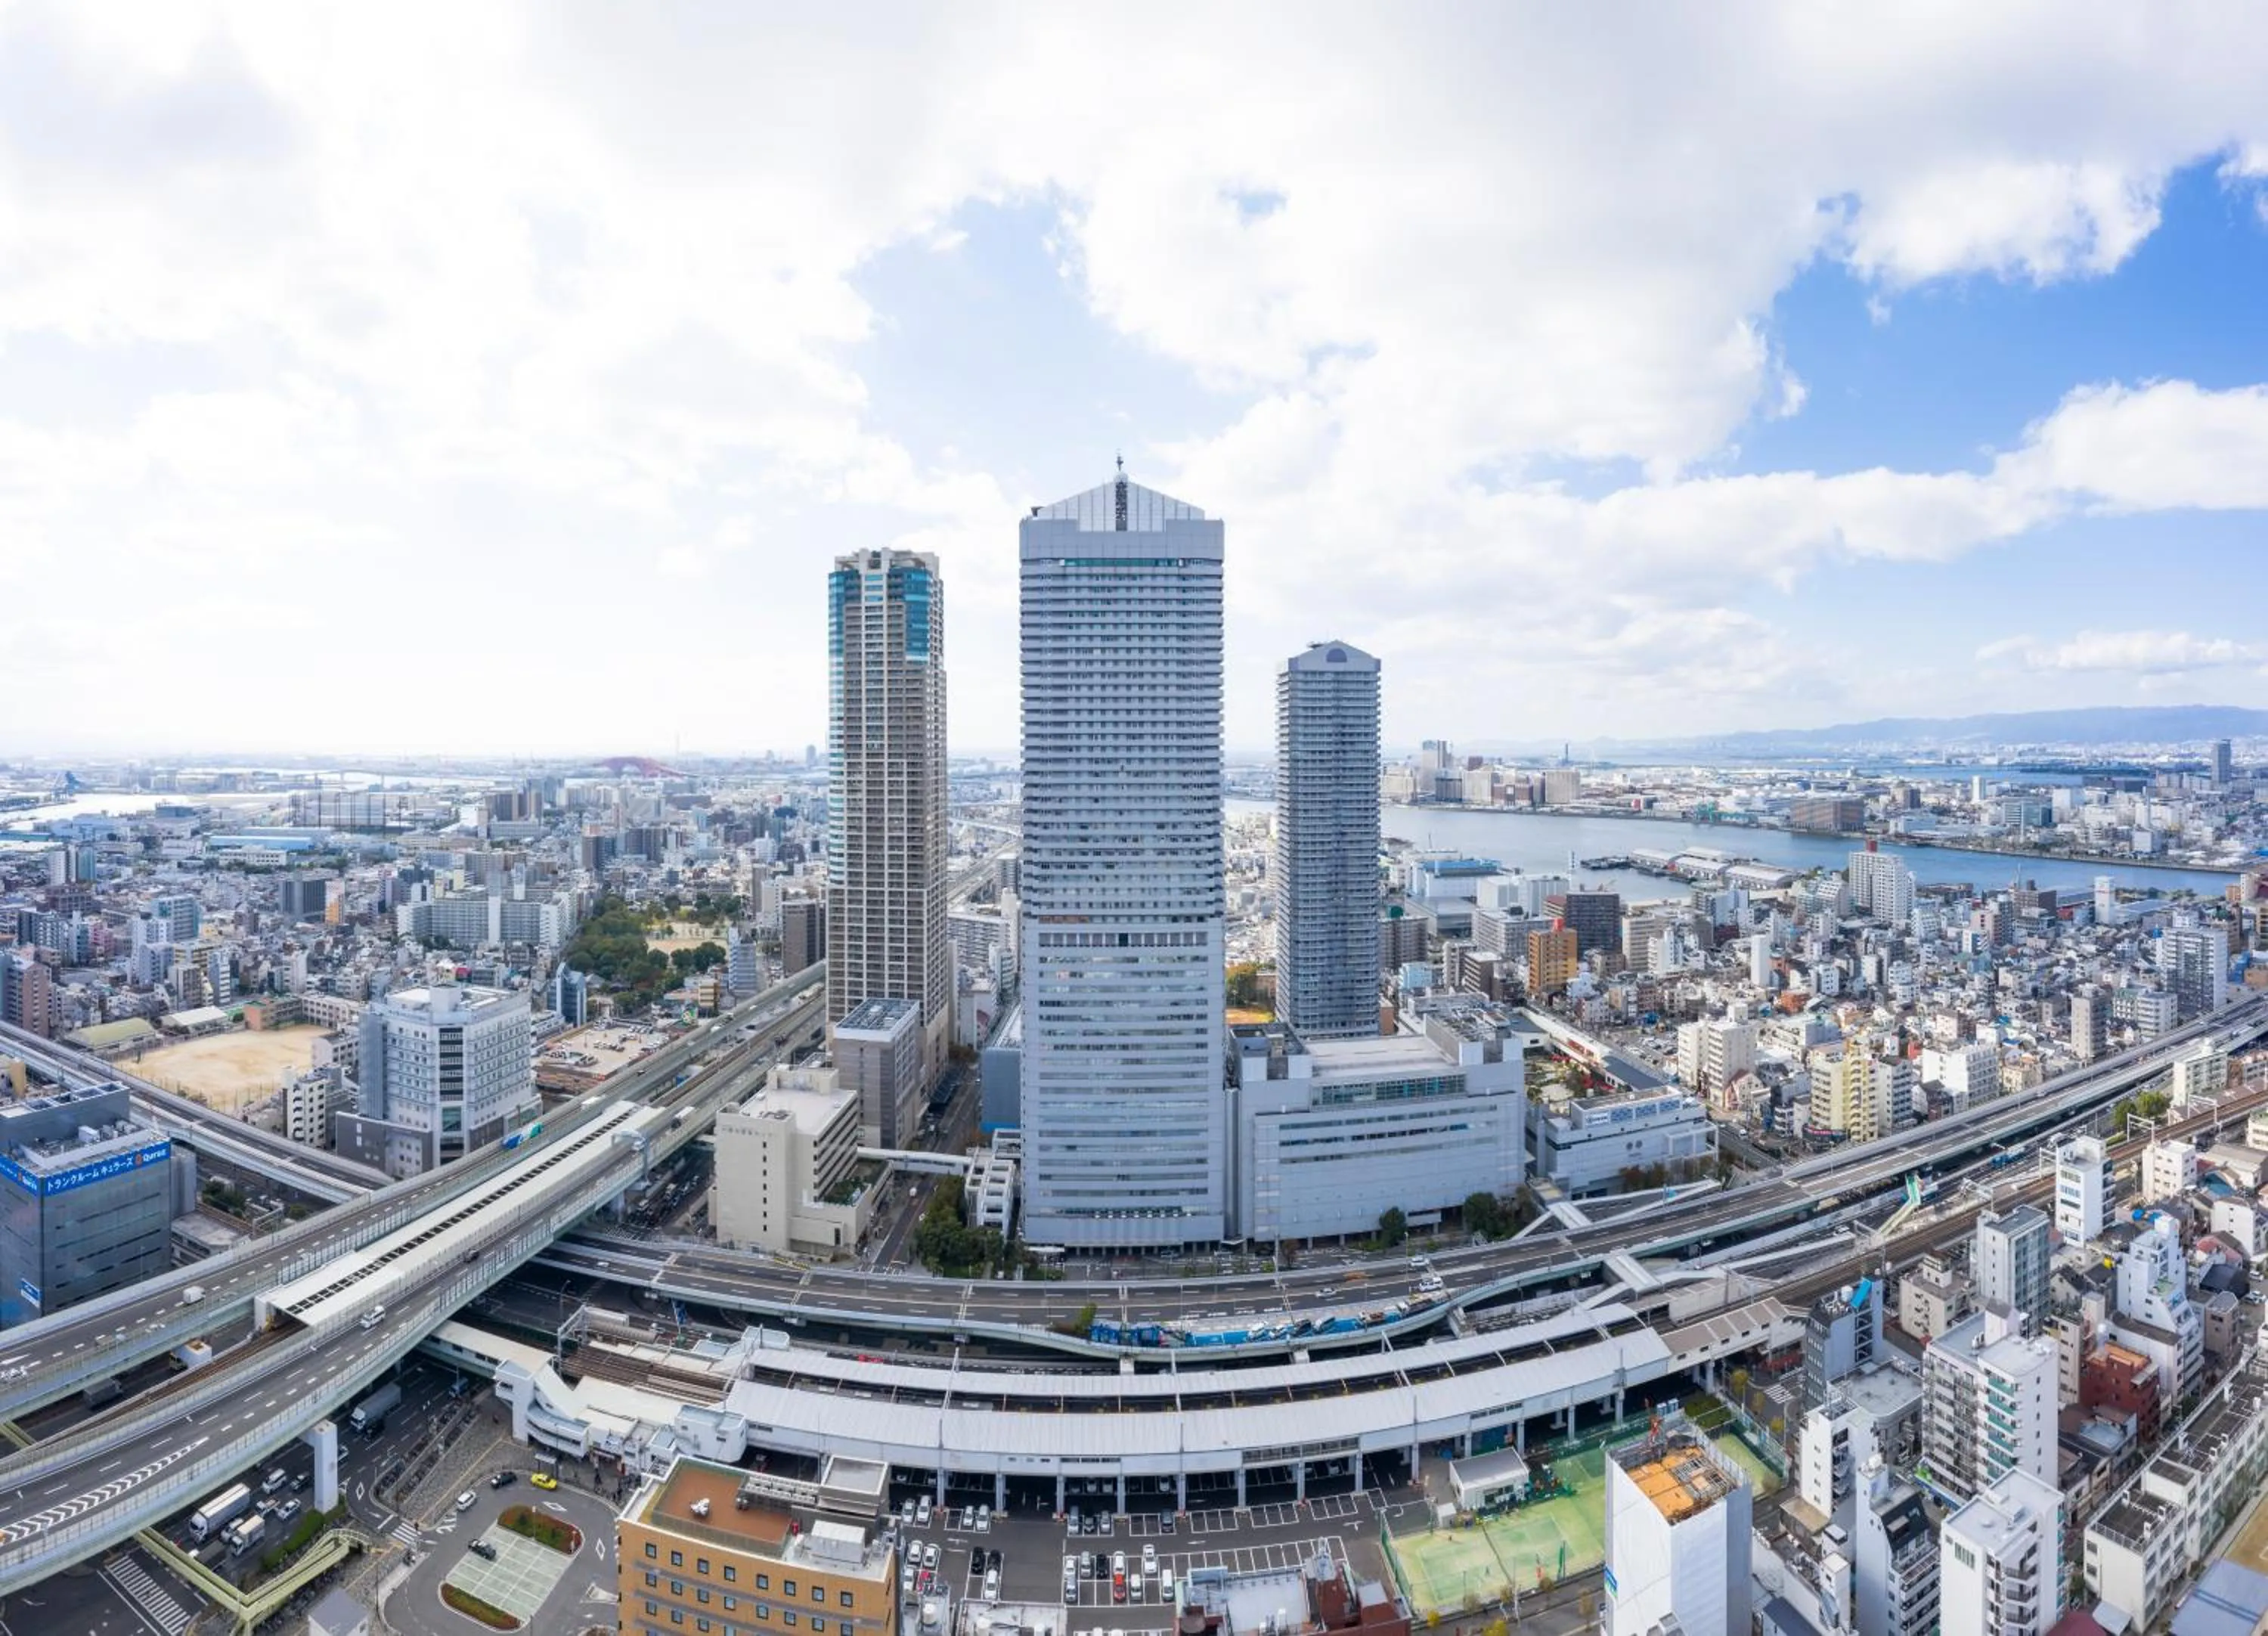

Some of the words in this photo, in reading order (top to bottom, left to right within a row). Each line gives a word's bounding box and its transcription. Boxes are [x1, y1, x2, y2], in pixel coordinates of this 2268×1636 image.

[48, 1168, 99, 1192] トランクルーム
